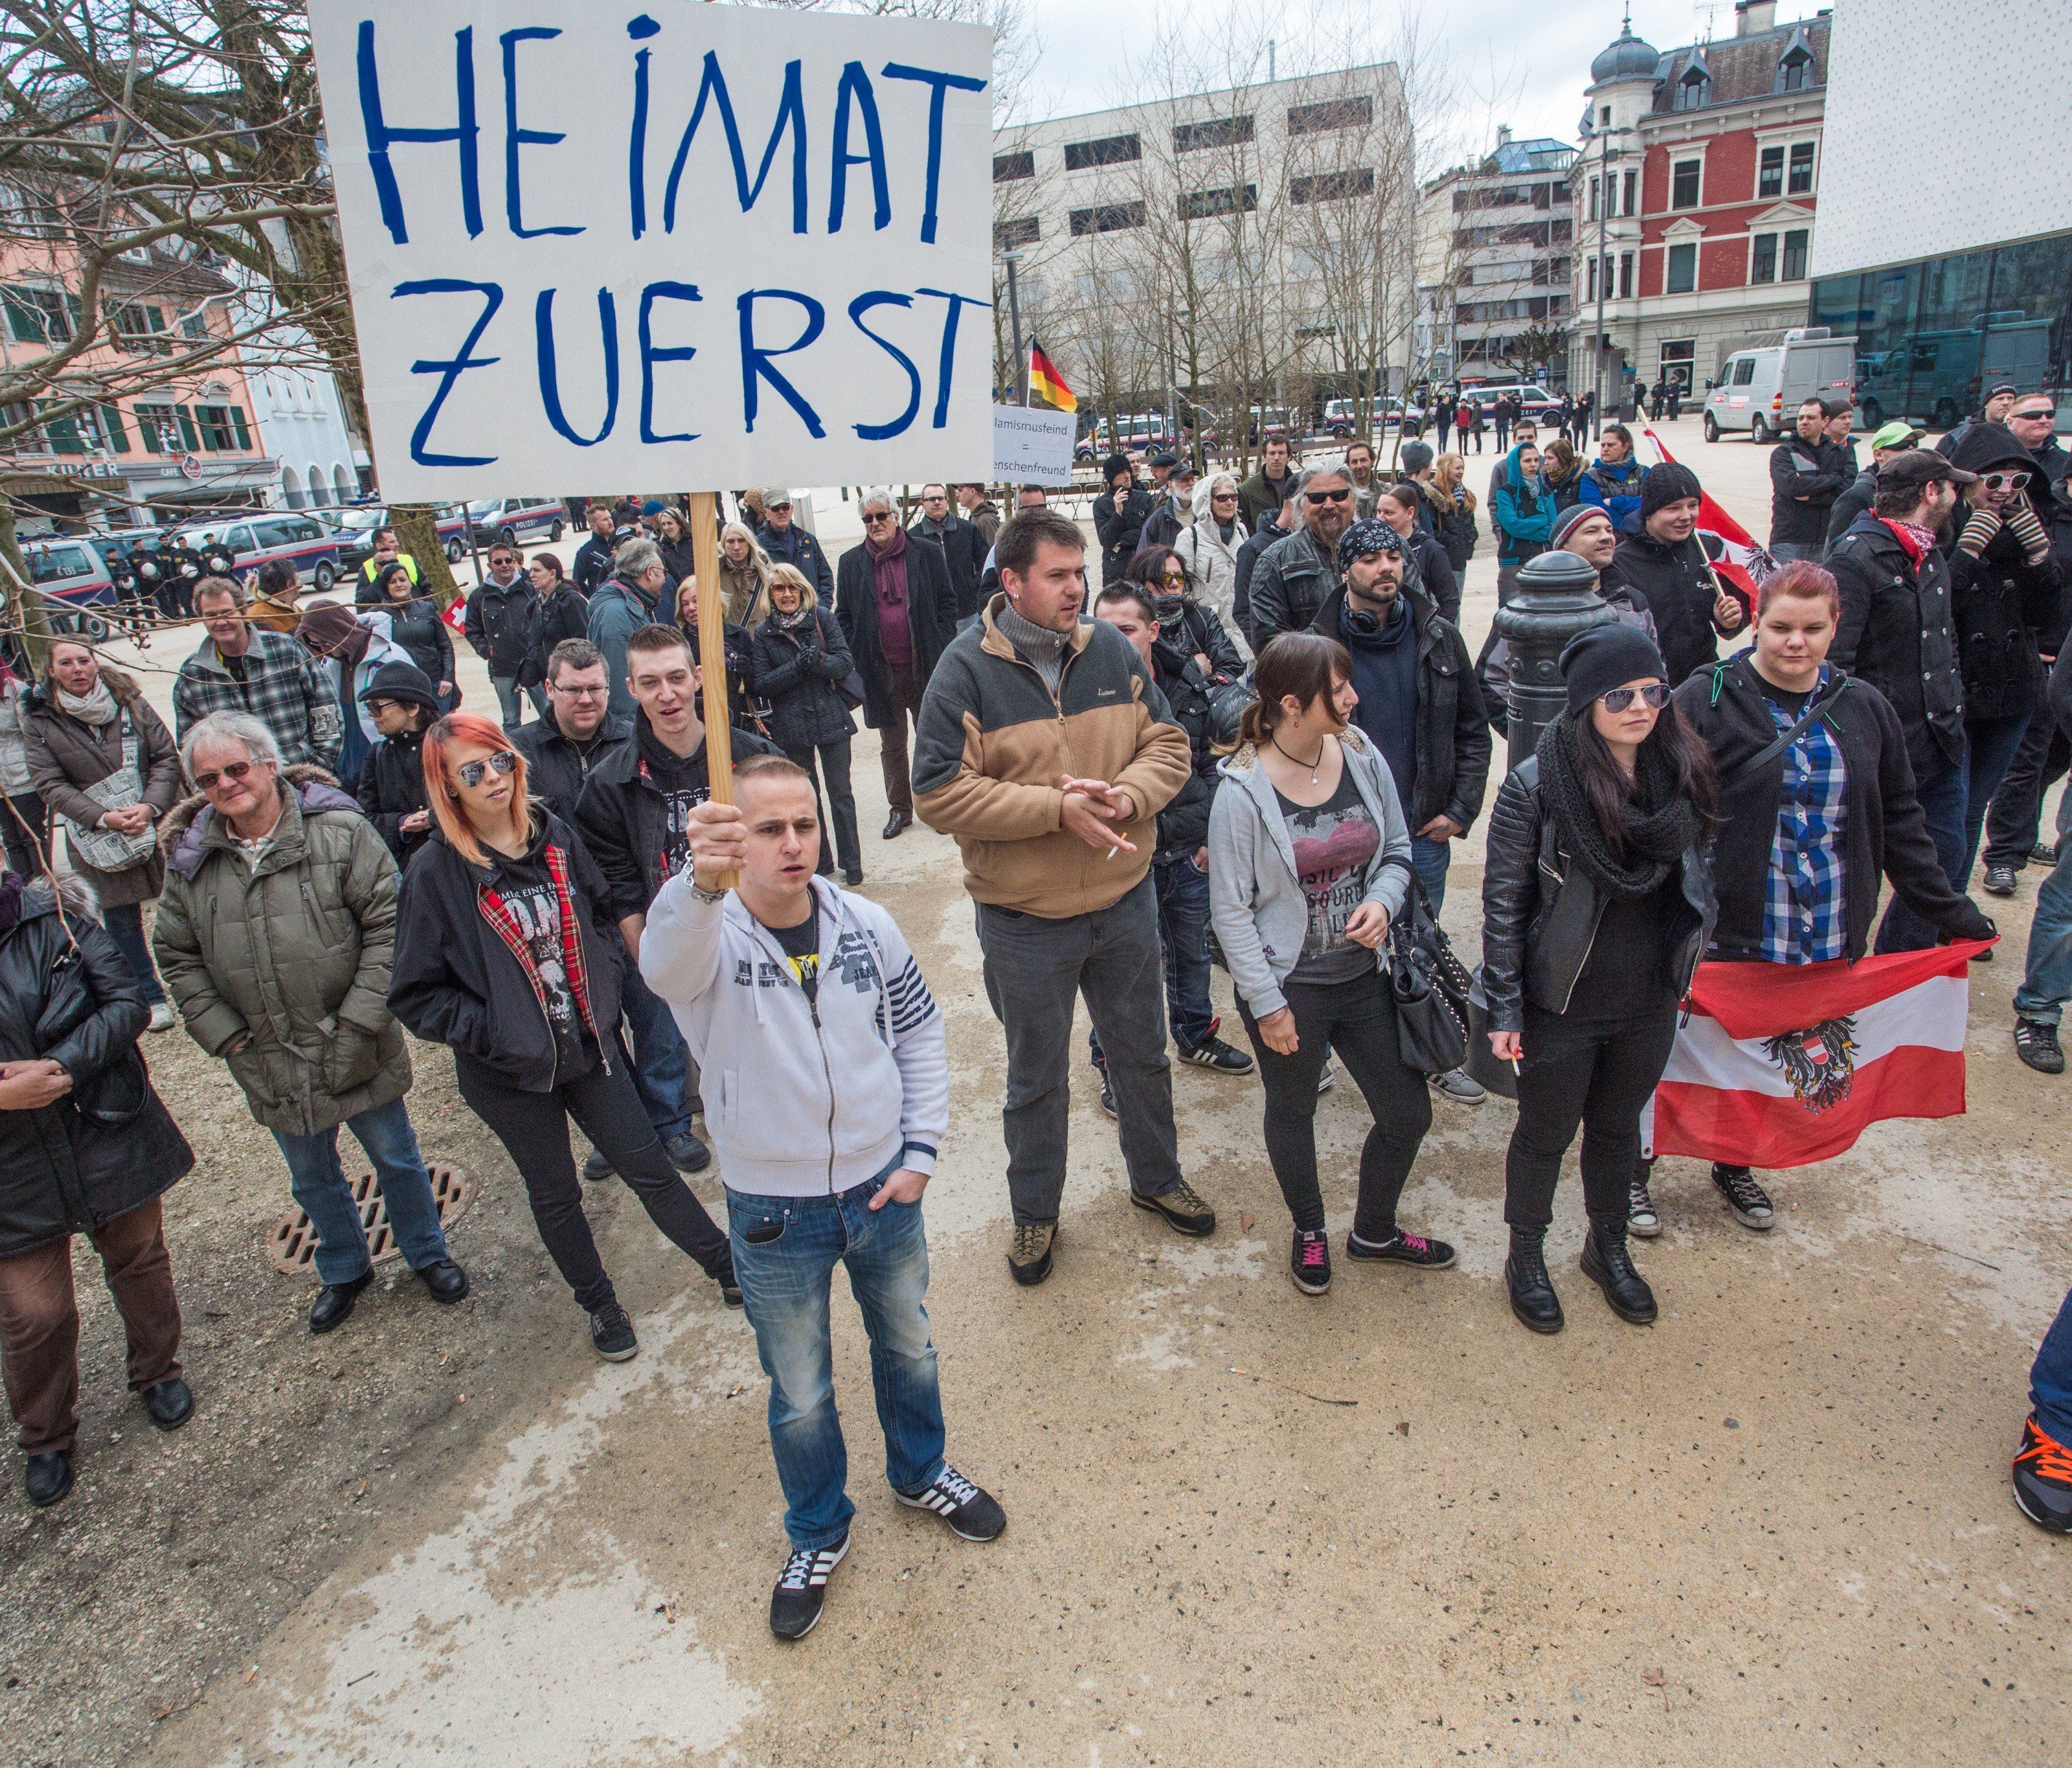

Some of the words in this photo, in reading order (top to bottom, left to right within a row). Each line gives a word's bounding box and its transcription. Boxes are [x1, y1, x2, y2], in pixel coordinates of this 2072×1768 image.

[390, 278, 991, 467] ZUERST
[994, 417, 1068, 435] lamismusfeind
[161, 468, 179, 477] CAFE
[993, 460, 1066, 476] enschenfreund
[516, 519, 535, 529] POLIZEI
[523, 885, 546, 897] EINE
[1307, 885, 1364, 908] SOURC
